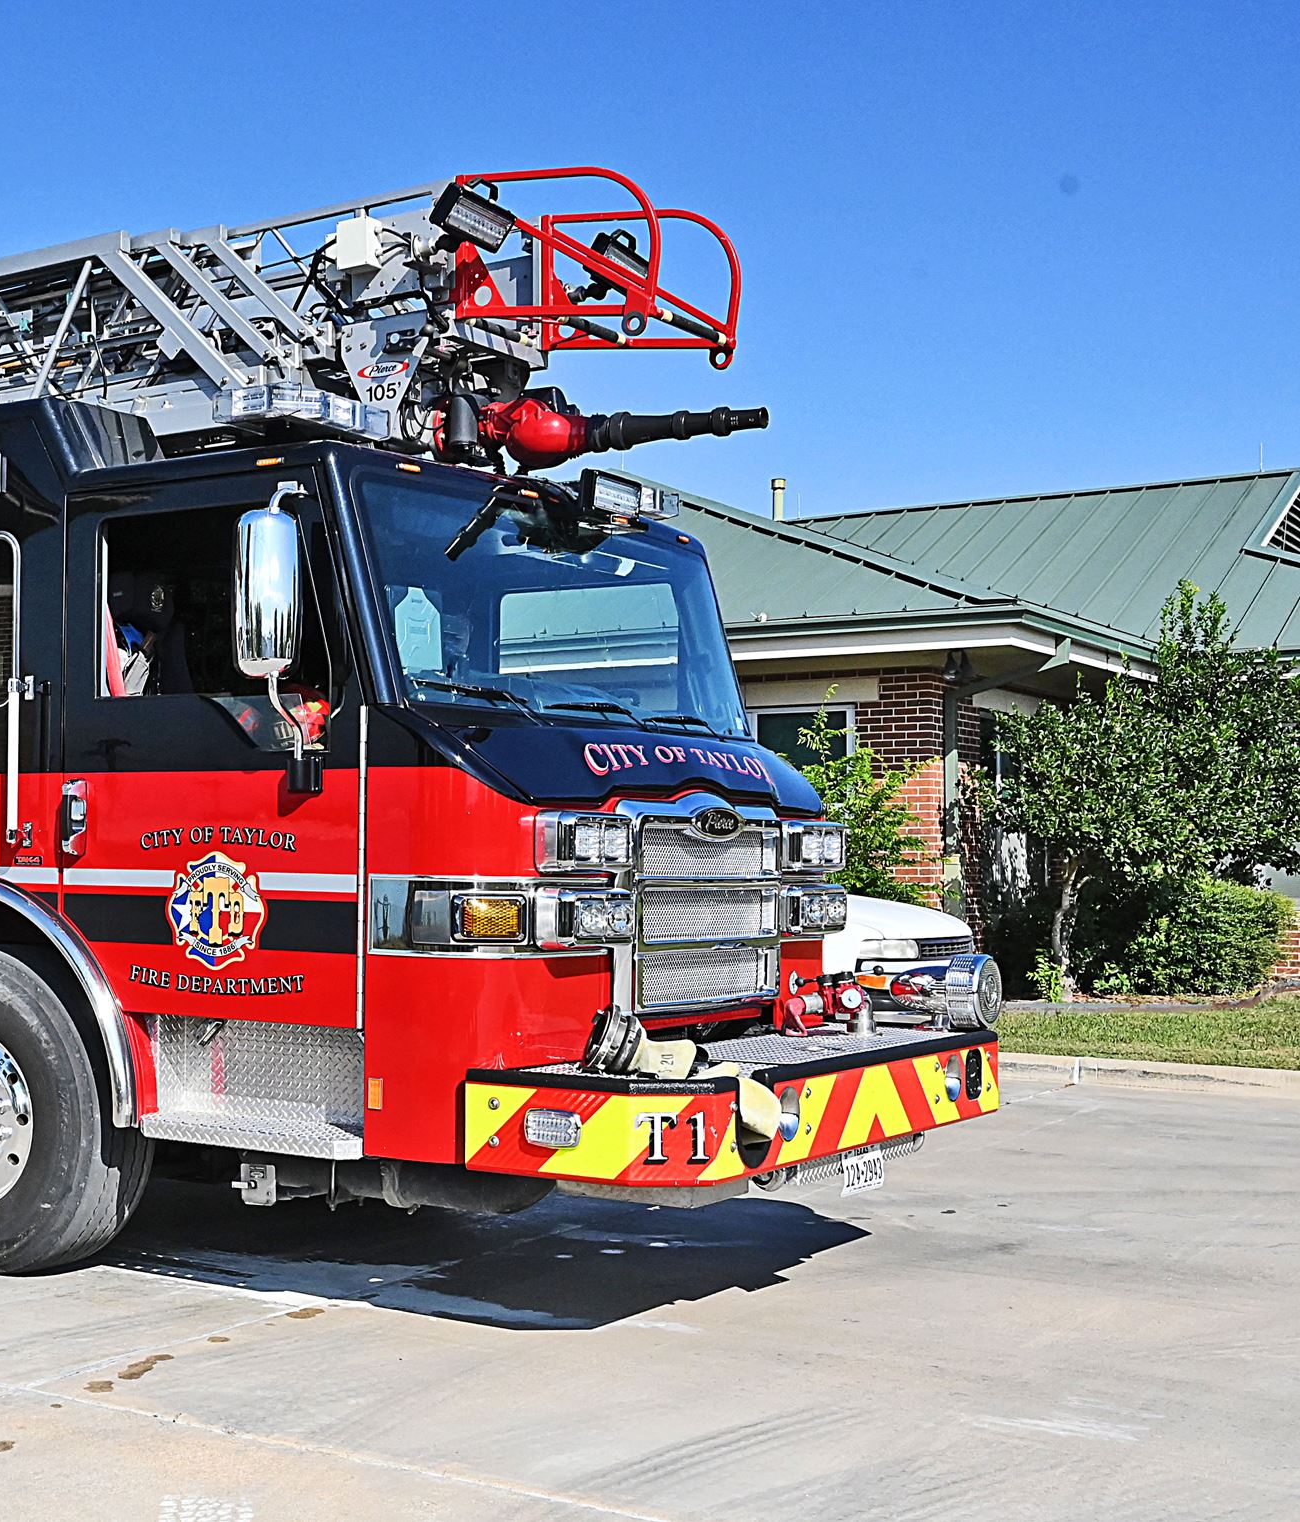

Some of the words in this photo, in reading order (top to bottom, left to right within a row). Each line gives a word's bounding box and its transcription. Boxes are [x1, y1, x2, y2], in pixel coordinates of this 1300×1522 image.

[369, 364, 397, 376] Pierce
[583, 742, 649, 777] CITY
[654, 745, 687, 764] OF
[704, 811, 735, 837] Pierce
[140, 828, 184, 851] CITY
[190, 826, 215, 844] OF
[220, 826, 297, 852] TAYLOR
[188, 864, 216, 884] PROUDLY
[217, 864, 245, 885] SERVING
[194, 941, 217, 956] SINCE
[219, 943, 236, 956] 1886
[129, 964, 171, 989] FIRE
[177, 974, 305, 996] DEPARTMENT
